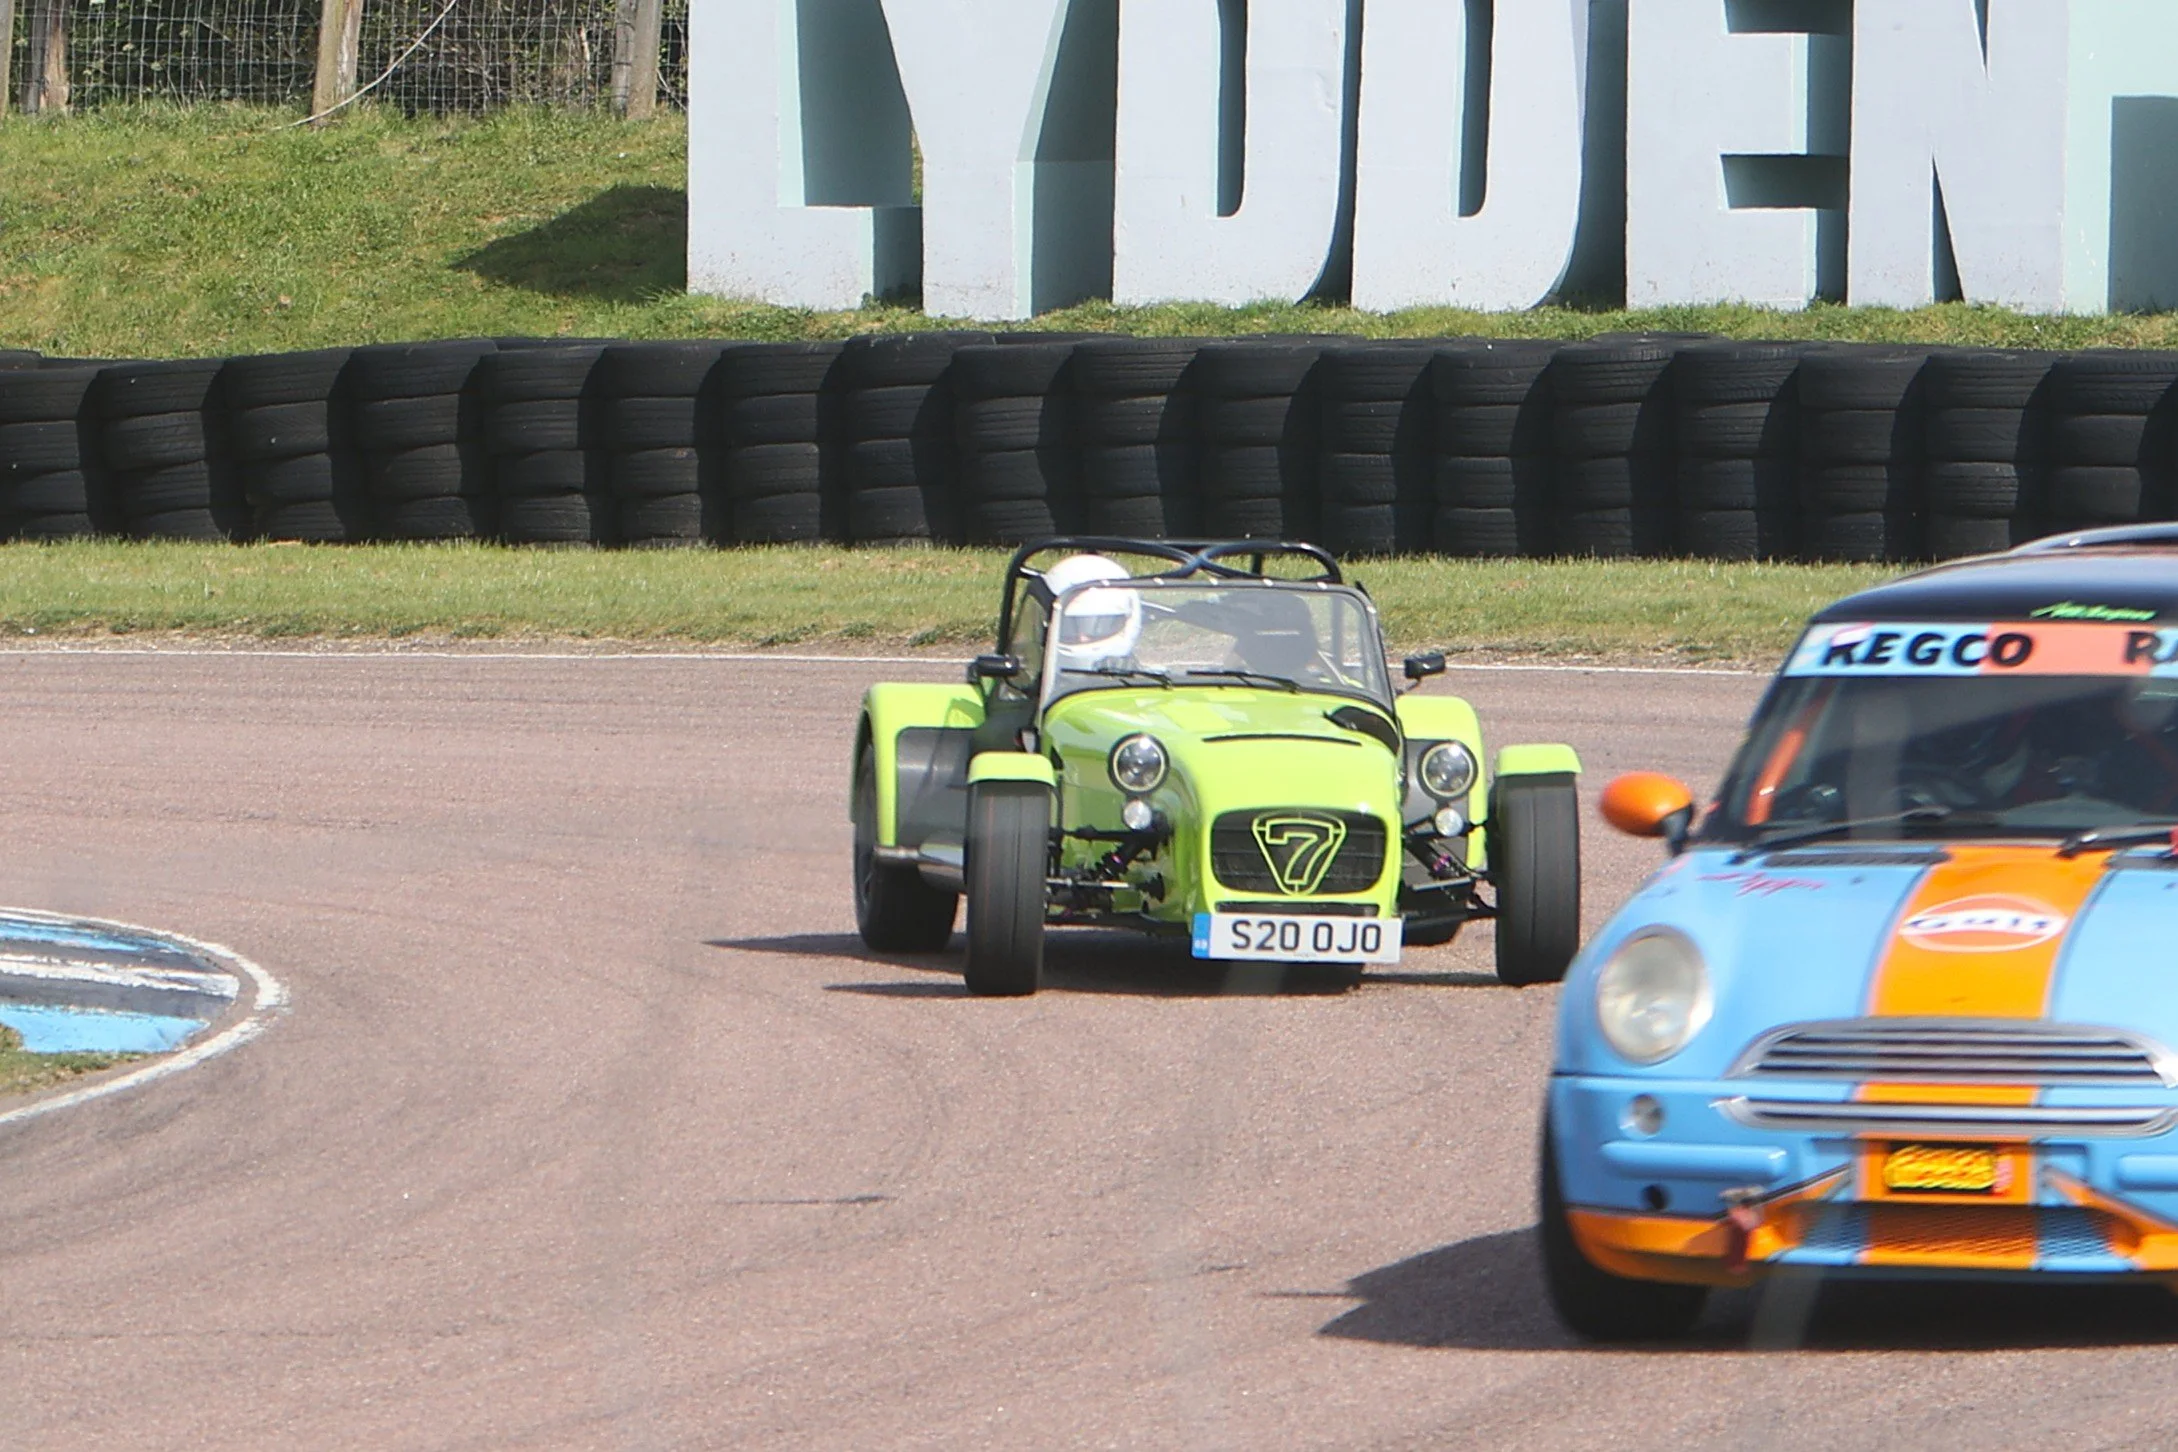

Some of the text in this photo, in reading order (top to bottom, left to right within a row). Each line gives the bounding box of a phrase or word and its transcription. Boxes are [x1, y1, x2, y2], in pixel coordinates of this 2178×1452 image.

[1820, 631, 2034, 668] KEGCO
[1265, 817, 1334, 886] 7
[1231, 919, 1381, 954] S20 OJO
